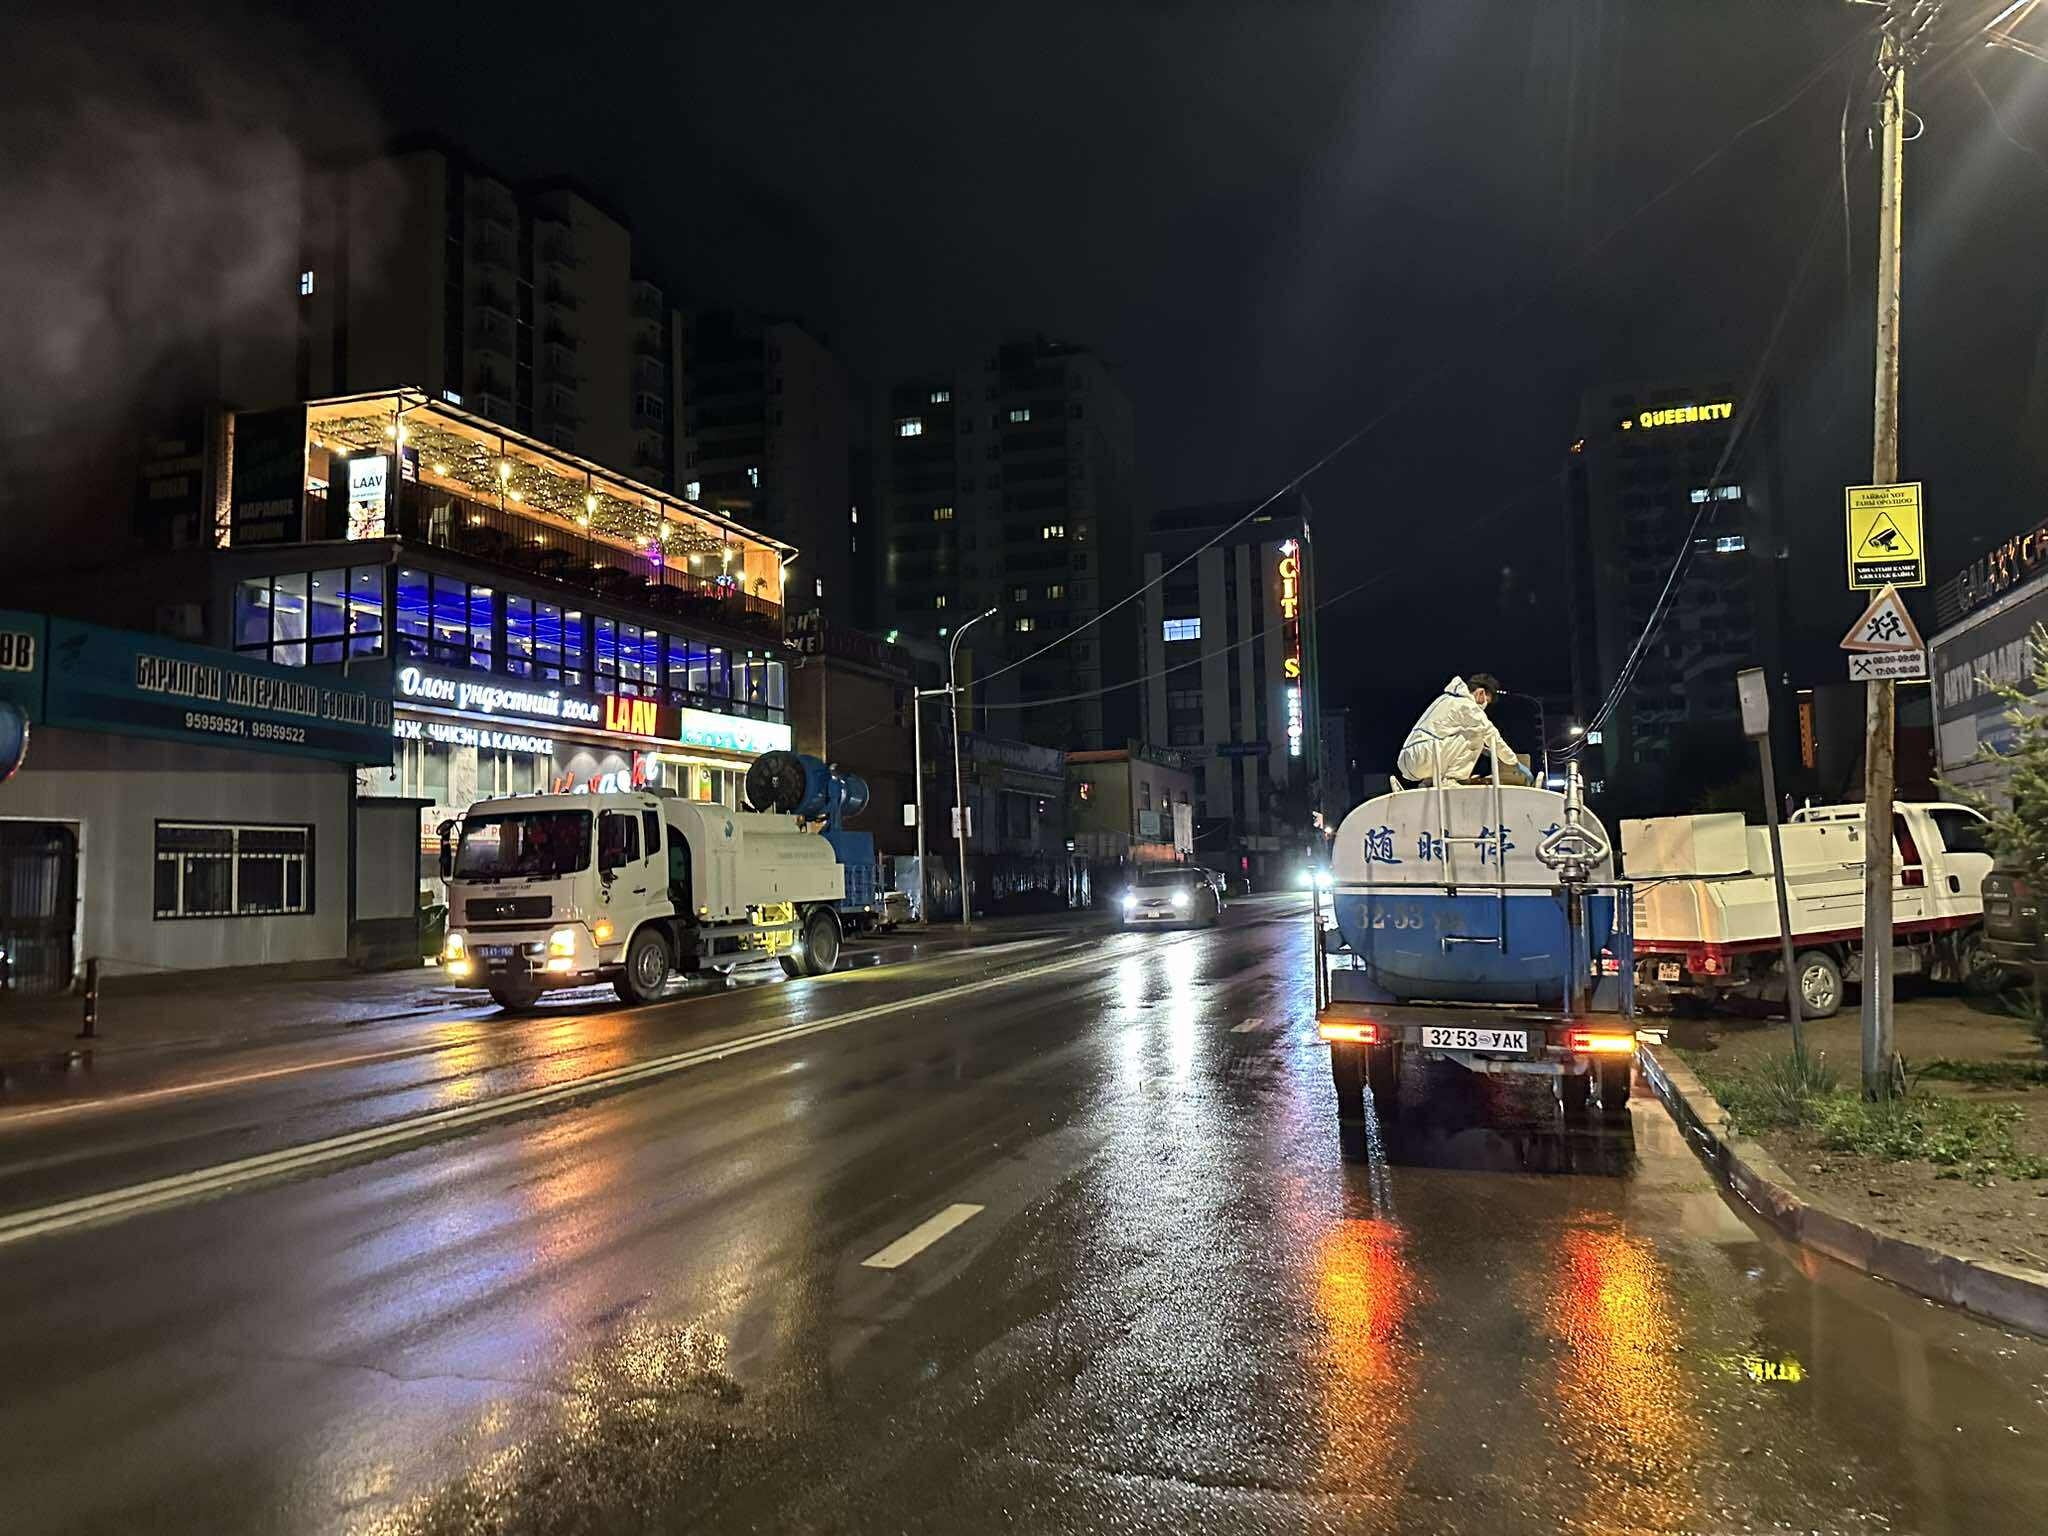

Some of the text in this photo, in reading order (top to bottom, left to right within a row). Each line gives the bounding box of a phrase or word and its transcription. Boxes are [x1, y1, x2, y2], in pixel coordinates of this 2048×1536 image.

[353, 476, 382, 488] LAAV
[136, 654, 222, 701] БАРИЛГЫН
[225, 670, 318, 717] МАТЕРИАЛЫН
[606, 695, 658, 736] LAAV
[252, 722, 305, 742] 95959522
[428, 723, 478, 746] ЧИКЭН
[480, 730, 491, 748] &
[492, 732, 553, 755] КАРАОКЕ
[1491, 1033, 1523, 1049] УАК
